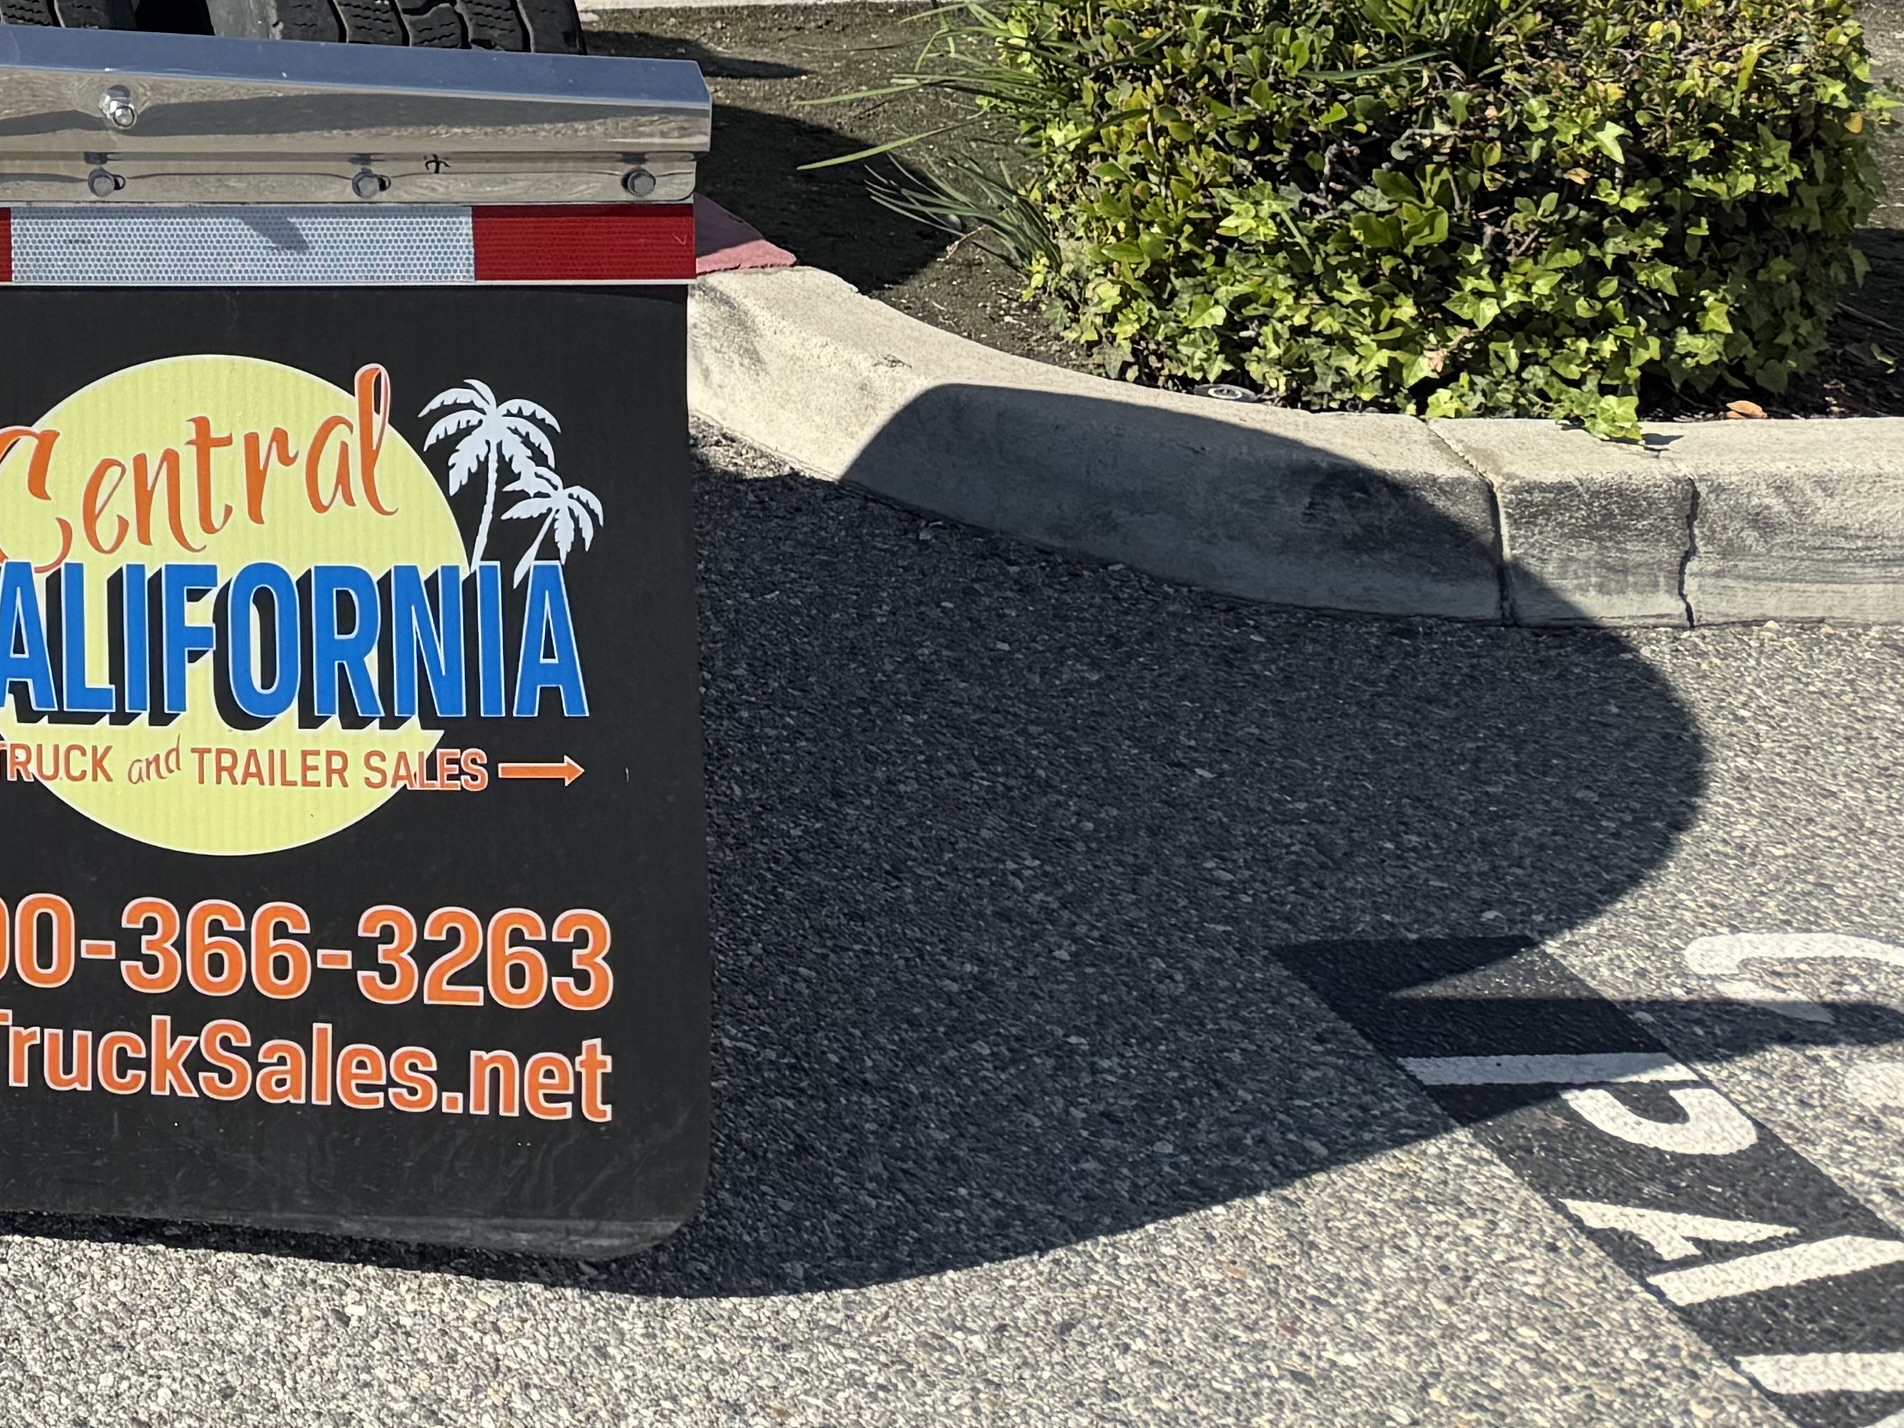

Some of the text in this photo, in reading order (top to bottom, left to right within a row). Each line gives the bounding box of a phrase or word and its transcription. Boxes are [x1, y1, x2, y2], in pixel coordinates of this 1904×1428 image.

[127, 734, 183, 784] and
[191, 746, 351, 787] TRAILER
[362, 748, 488, 790] SALES
